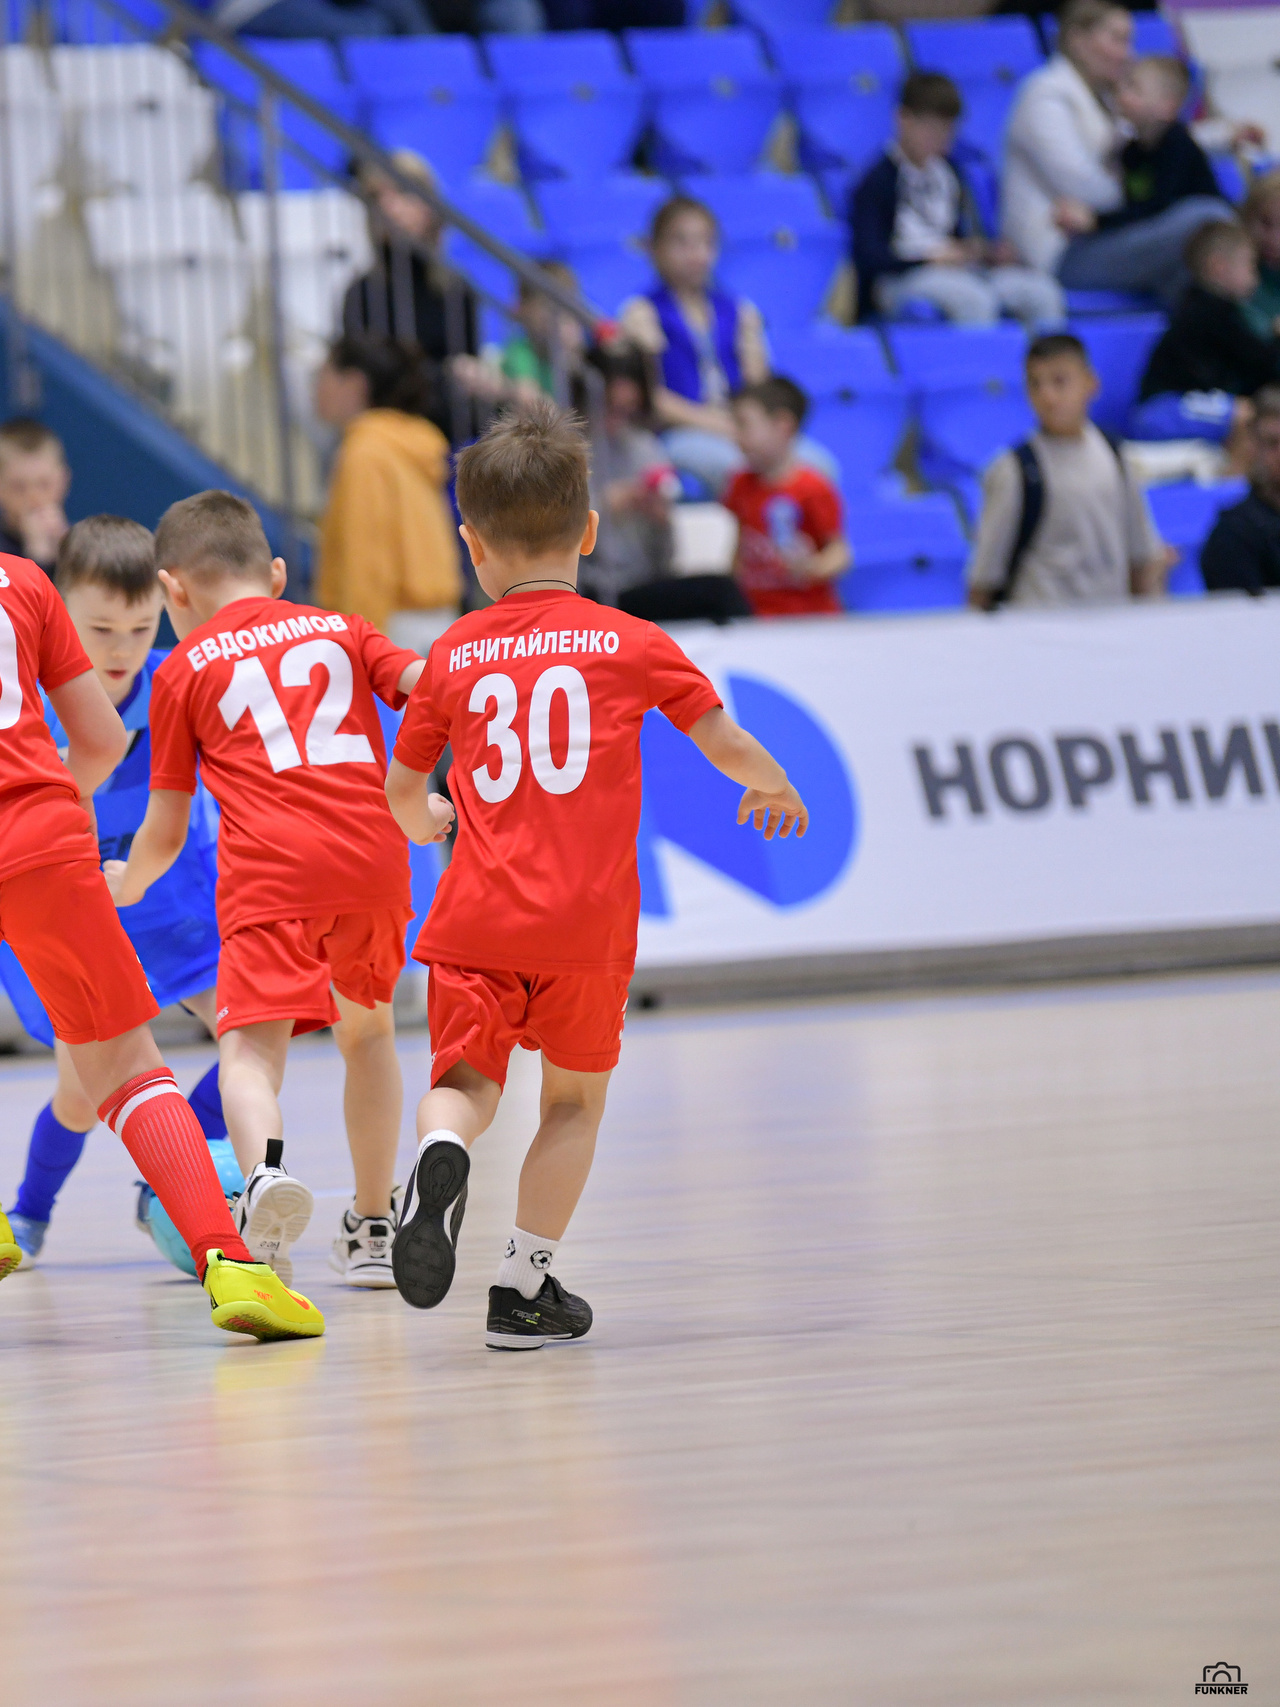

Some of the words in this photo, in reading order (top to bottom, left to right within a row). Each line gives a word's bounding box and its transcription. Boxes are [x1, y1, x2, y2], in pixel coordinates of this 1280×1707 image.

[186, 614, 349, 672] ЕВДОКИМОВ
[449, 628, 620, 673] НЕЧИТАЙЛЕНКО
[217, 638, 377, 774] 12
[468, 665, 591, 803] 30
